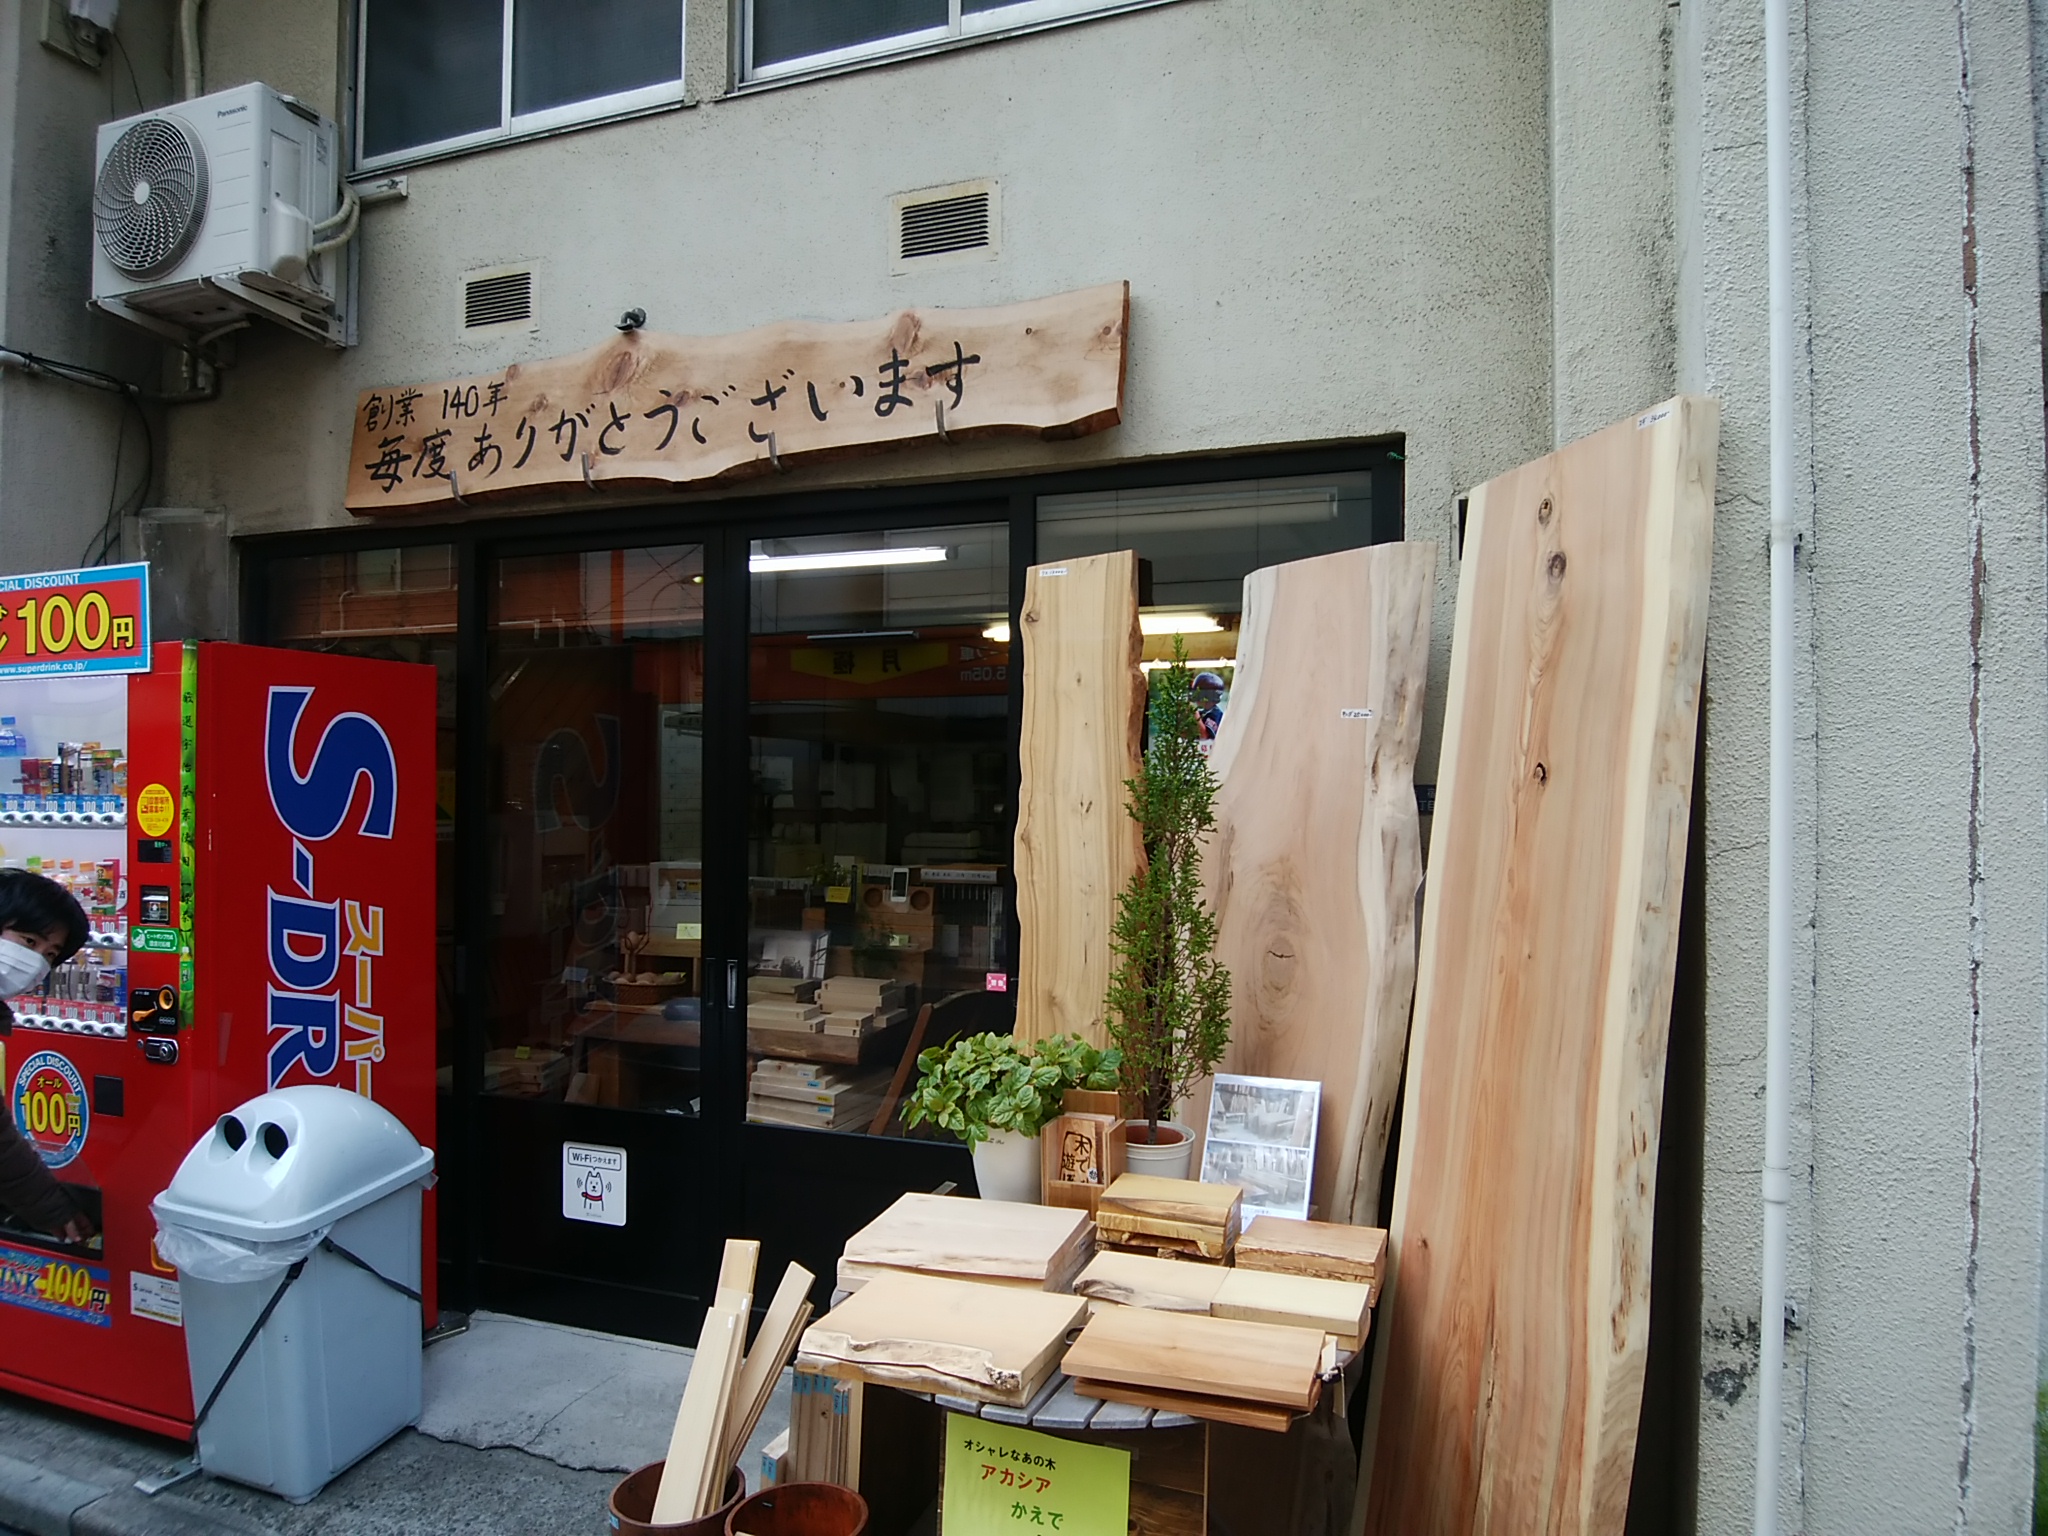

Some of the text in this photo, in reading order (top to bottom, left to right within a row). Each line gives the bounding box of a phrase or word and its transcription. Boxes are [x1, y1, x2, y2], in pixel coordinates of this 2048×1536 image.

[217, 104, 248, 118] Panasonic
[363, 380, 508, 432] 創業 140年
[364, 341, 982, 494] 毎度ありがとうございます
[25, 573, 80, 589] DISCOUNT
[16, 590, 134, 655] 100円
[102, 921, 115, 933] 100
[19, 1056, 82, 1092] SPECIAL DISCOUNT
[37, 1076, 63, 1089] オール
[963, 1438, 1057, 1471] オシャレなあの木
[980, 1463, 1051, 1494] アカシア
[1010, 1500, 1064, 1531] かえで
